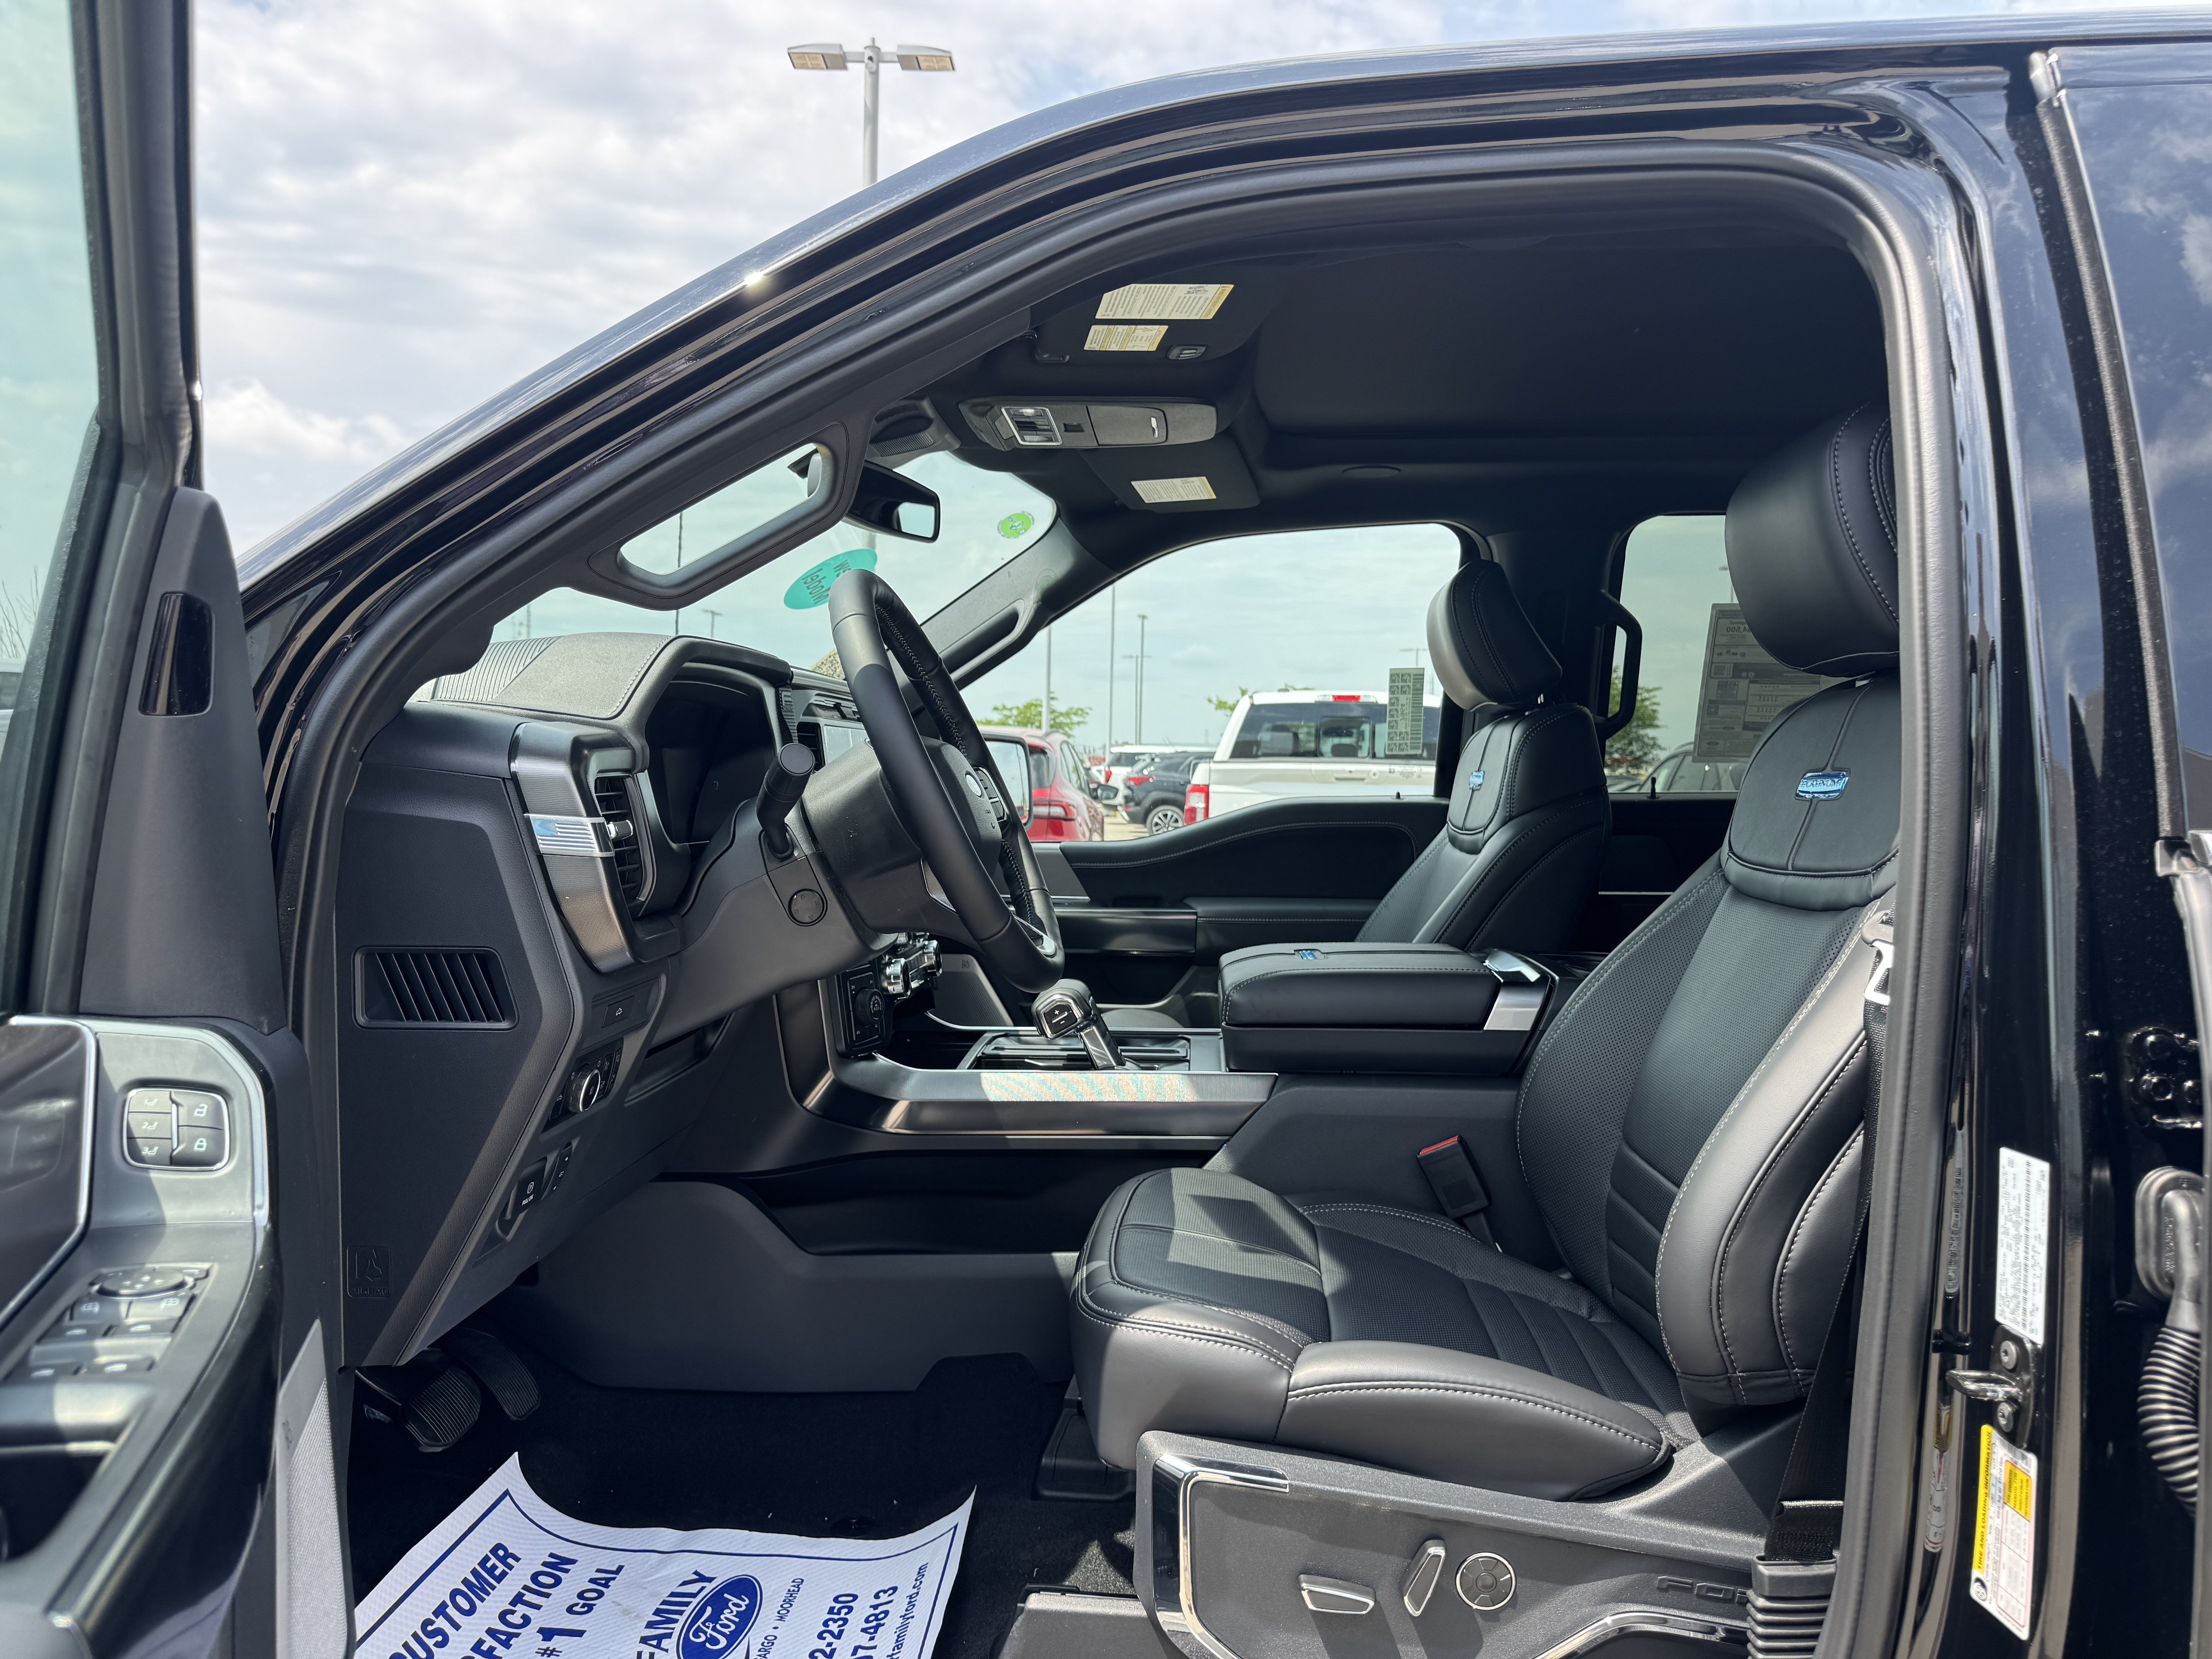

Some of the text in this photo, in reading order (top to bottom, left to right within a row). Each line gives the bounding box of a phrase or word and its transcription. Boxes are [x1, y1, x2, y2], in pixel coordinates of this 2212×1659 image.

[389, 1542, 522, 1659] USTOMER
[461, 1552, 578, 1659] FACTION
[566, 1565, 625, 1615] GOAL
[689, 1593, 749, 1649] Ford
[753, 1577, 804, 1659] ARGO MOORHEAD
[850, 1586, 898, 1659] 7-4813
